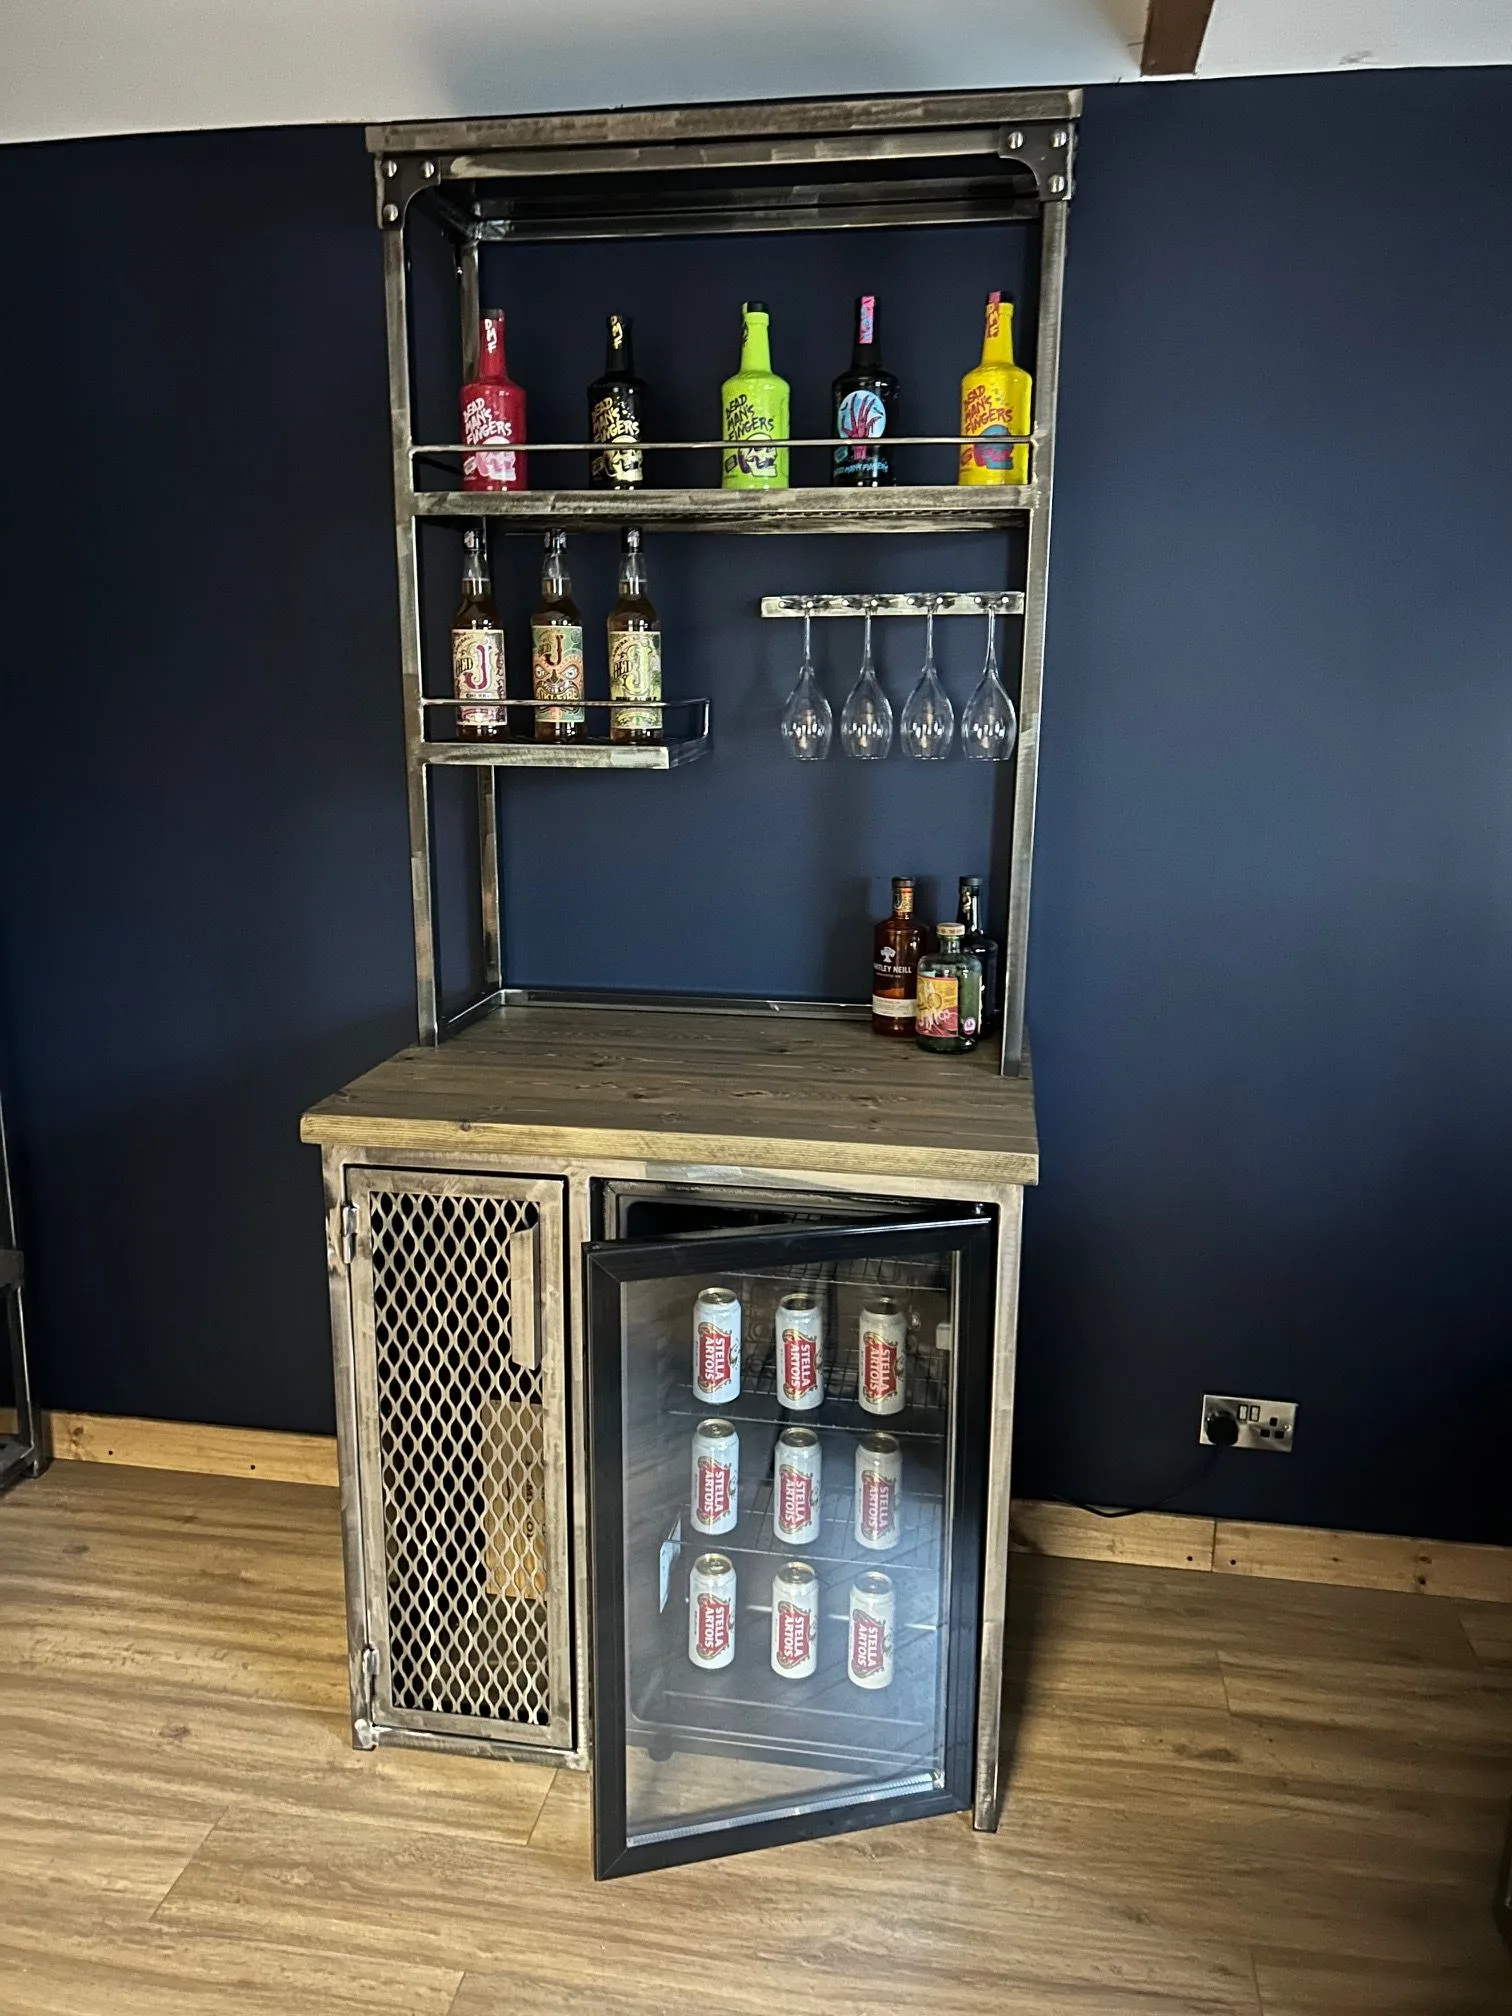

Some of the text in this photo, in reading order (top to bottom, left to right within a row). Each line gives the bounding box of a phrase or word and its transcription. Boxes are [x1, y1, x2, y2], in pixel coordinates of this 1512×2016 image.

[463, 398, 485, 423] DEAD
[726, 394, 747, 419] DEAD
[728, 404, 755, 431] MAN'S
[965, 385, 985, 411] DEAD
[466, 408, 493, 434] MAN'S
[467, 421, 512, 445] FINGERS
[594, 420, 640, 442] FINGERS
[729, 417, 774, 440] FINGERS
[966, 408, 1013, 434] FINGERS
[463, 644, 492, 690] J
[893, 966, 912, 974] NEILL
[704, 1337, 715, 1381] ARTOIS
[715, 1338, 725, 1380] STELLA
[790, 1343, 800, 1388] ARTOIS
[800, 1344, 810, 1387] STELLA
[870, 1347, 881, 1395] ARTOIS
[880, 1348, 890, 1391] STELLA
[704, 1470, 714, 1513] ARTOIS
[715, 1471, 724, 1512] STELLA
[785, 1478, 796, 1522] ARTOIS
[795, 1480, 806, 1521] STELLA
[868, 1485, 878, 1528] ARTOIS
[879, 1486, 889, 1527] STELLA
[704, 1606, 715, 1648] ARTOIS
[714, 1606, 725, 1647] STELLA
[784, 1615, 795, 1658] ARTOIS
[794, 1616, 805, 1657] STELLA
[857, 1624, 868, 1667] ARTOIS
[868, 1626, 878, 1667] STELLA
